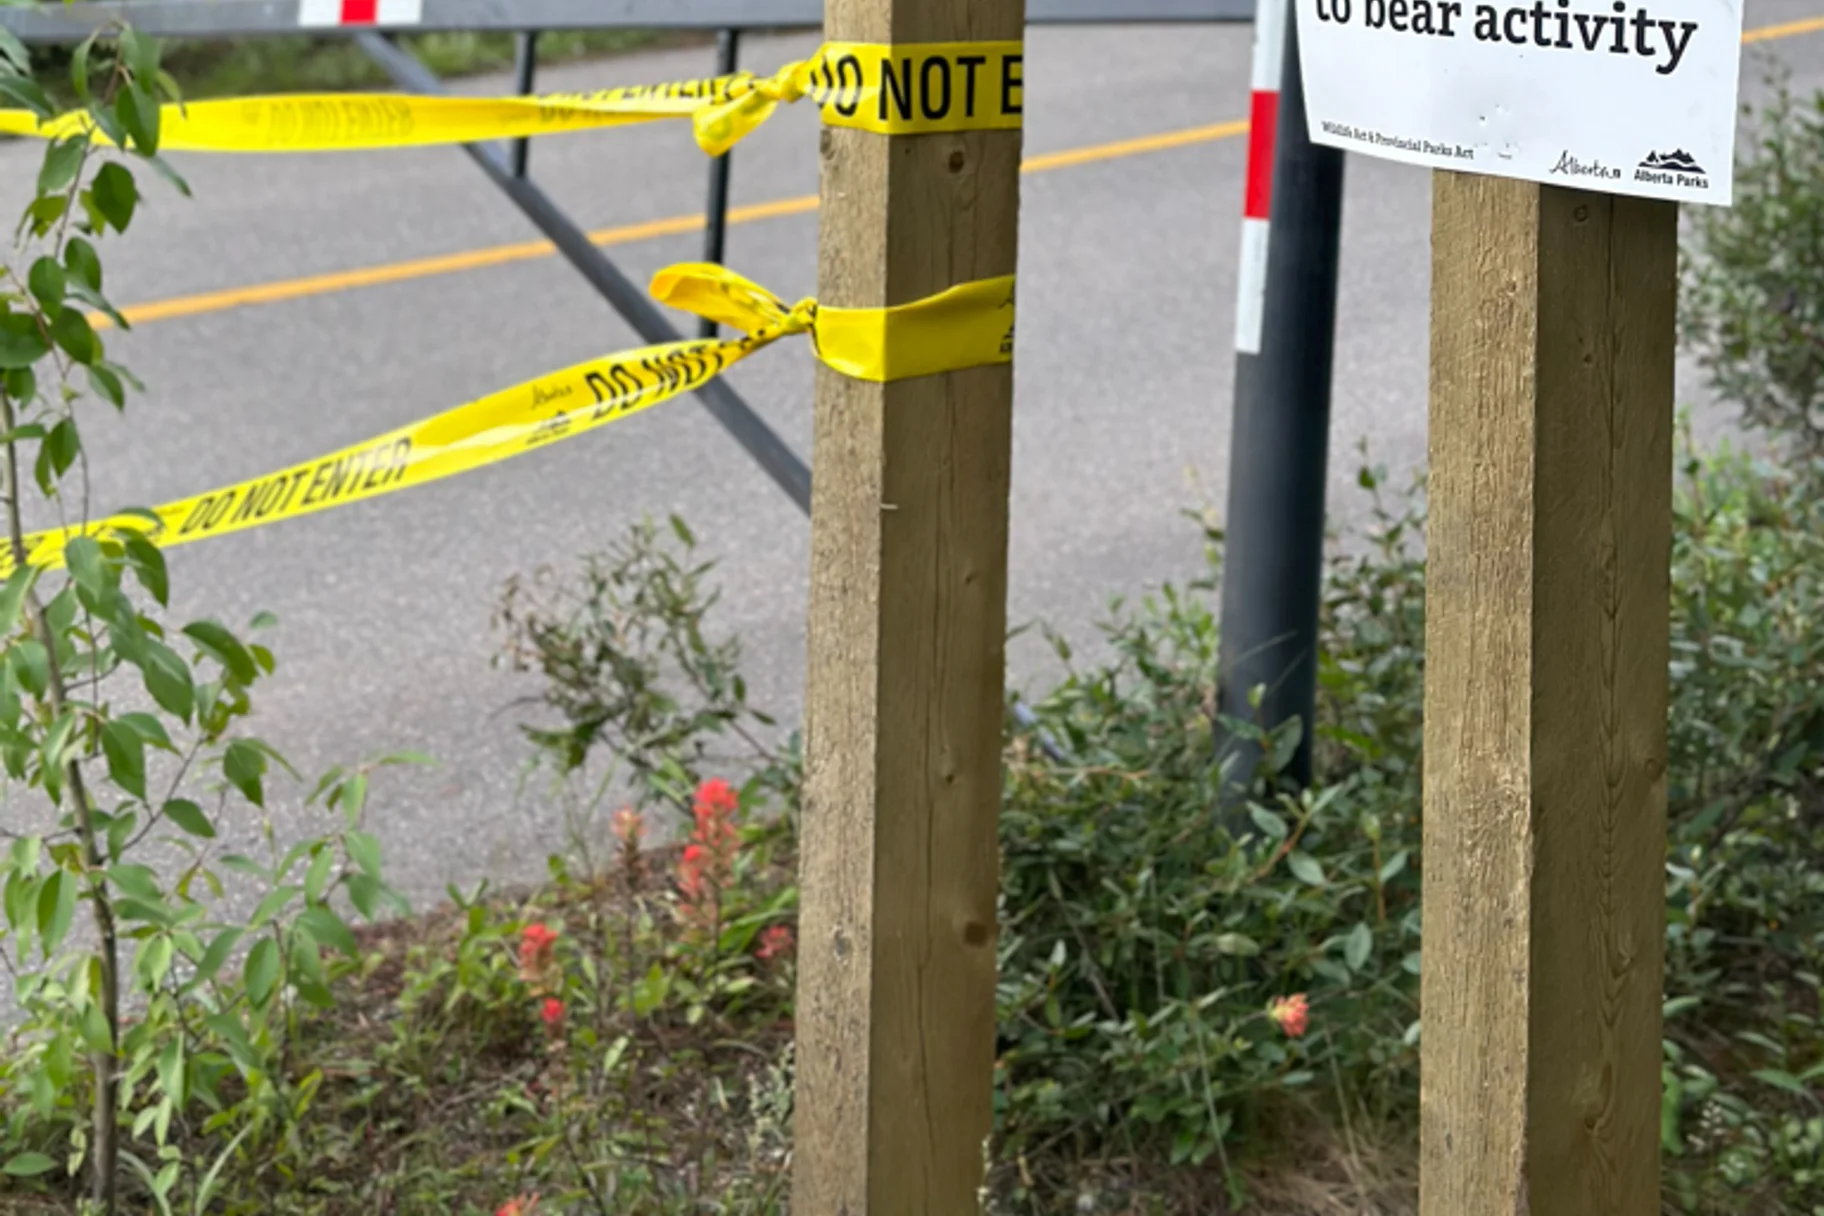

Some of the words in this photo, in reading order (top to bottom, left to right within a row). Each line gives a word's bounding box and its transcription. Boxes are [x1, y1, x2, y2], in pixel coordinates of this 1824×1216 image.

[878, 55, 986, 121] NOT
[1634, 168, 1674, 186] Alberta
[1676, 173, 1709, 190] Parks
[179, 489, 237, 536] DO
[230, 467, 312, 524] NOT
[301, 435, 412, 506] ENTER
